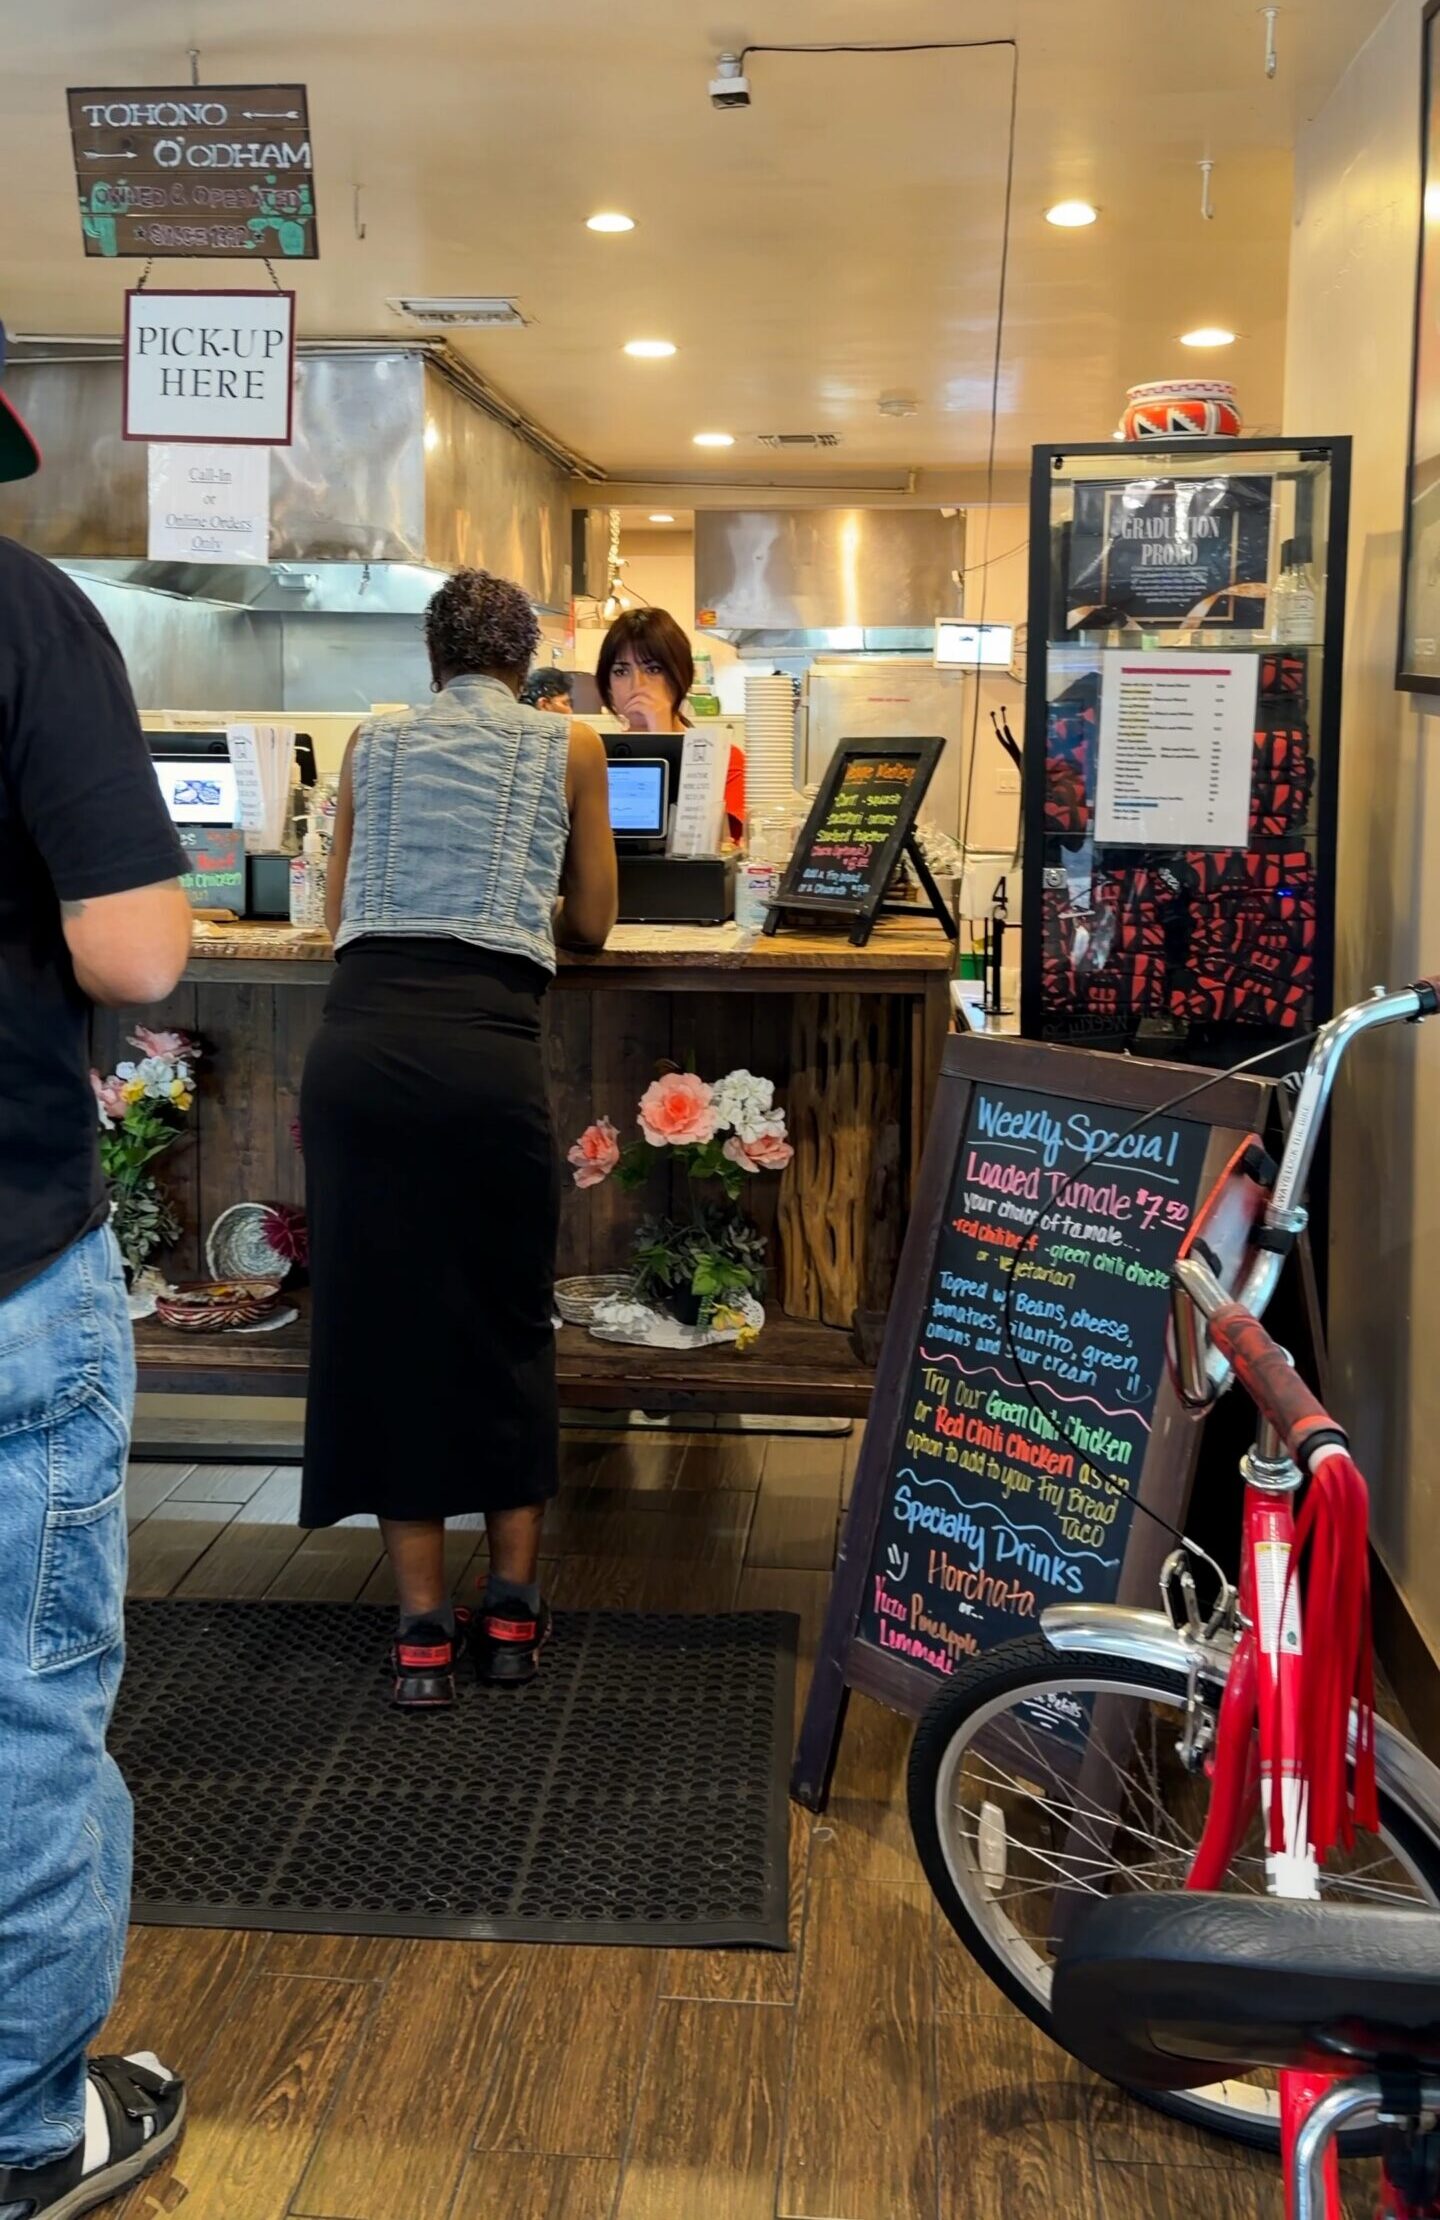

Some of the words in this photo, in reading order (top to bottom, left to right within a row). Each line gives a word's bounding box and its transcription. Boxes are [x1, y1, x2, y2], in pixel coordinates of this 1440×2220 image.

[81, 102, 228, 127] TOHONO
[149, 223, 208, 247] SINCE
[137, 326, 283, 358] PICK-UP
[160, 368, 264, 399] HERE
[203, 496, 216, 505] or
[166, 514, 207, 527] Online
[210, 516, 252, 529] Orders
[1121, 516, 1220, 539] GRADUTION
[192, 536, 222, 549] Only
[1141, 543, 1198, 565] PROMO
[978, 1097, 1064, 1167] Weekly
[1066, 1114, 1179, 1167] Special
[966, 1152, 1041, 1200] Loaded
[1044, 1171, 1133, 1220] Tamale
[963, 1192, 998, 1214] your
[1040, 1213, 1061, 1232] of
[976, 1250, 990, 1262] or
[1093, 1252, 1126, 1278] chili
[1125, 1261, 1171, 1290] chicke
[939, 1271, 988, 1300] Topped
[925, 1322, 972, 1347] onions
[975, 1336, 1002, 1356] and
[1042, 1353, 1098, 1387] cream
[1009, 1319, 1077, 1361] ilantro,
[1081, 1345, 1139, 1373] green
[921, 1367, 949, 1408] Try
[954, 1378, 988, 1411] Our
[985, 1389, 1029, 1432] Green
[1064, 1415, 1133, 1465] Chicken
[914, 1400, 933, 1422] or
[934, 1404, 966, 1439] Red
[965, 1418, 1004, 1453] Chili
[1005, 1432, 1075, 1479] Chicken
[905, 1428, 944, 1460] option
[944, 1441, 959, 1464] to
[959, 1449, 987, 1477] add
[986, 1457, 1001, 1480] to
[1000, 1465, 1036, 1500] your
[1036, 1474, 1066, 1516] Fry
[1066, 1487, 1120, 1526] Bread
[894, 1485, 985, 1573] Specialty
[1058, 1515, 1106, 1548] Taco
[874, 1574, 908, 1622] Yuzu
[927, 1548, 1036, 1618] Horchata
